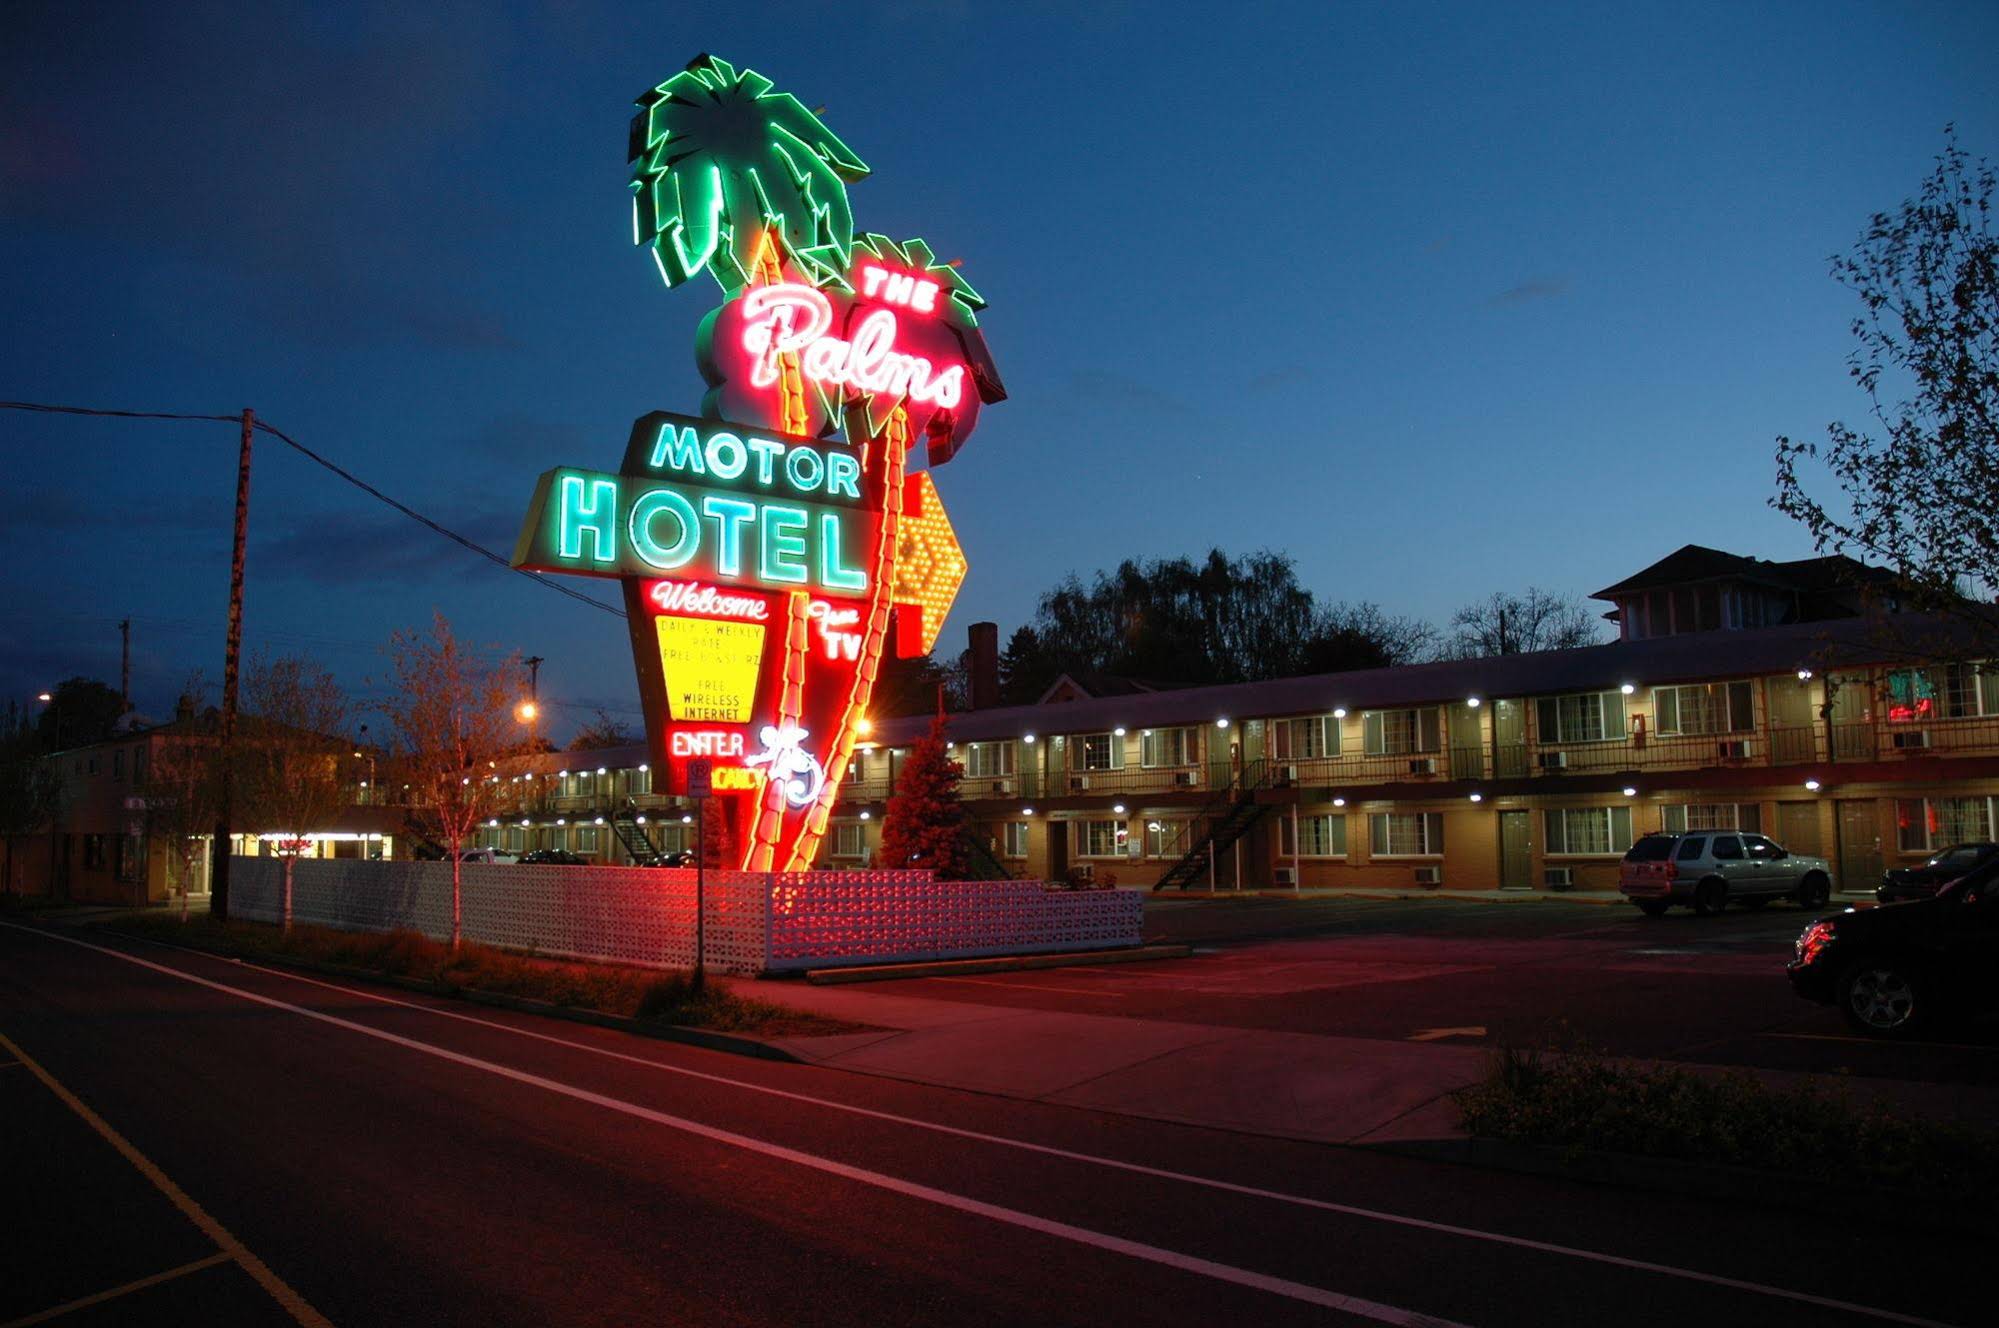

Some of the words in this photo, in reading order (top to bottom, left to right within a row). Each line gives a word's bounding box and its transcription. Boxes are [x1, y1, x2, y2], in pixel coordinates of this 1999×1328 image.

[863, 267, 939, 311] THE
[743, 284, 964, 408] Palms
[651, 423, 861, 498] MOTOR
[559, 476, 867, 591] HOTEL
[651, 581, 769, 619] Welcome
[716, 625, 760, 639] WEEKLY
[808, 600, 860, 637] Free
[825, 631, 863, 661] TV
[683, 693, 740, 707] WIRELESS
[697, 680, 726, 691] FREE
[684, 707, 739, 720] INTERNET
[672, 732, 744, 756] ENTER
[711, 767, 766, 789] CANCY
